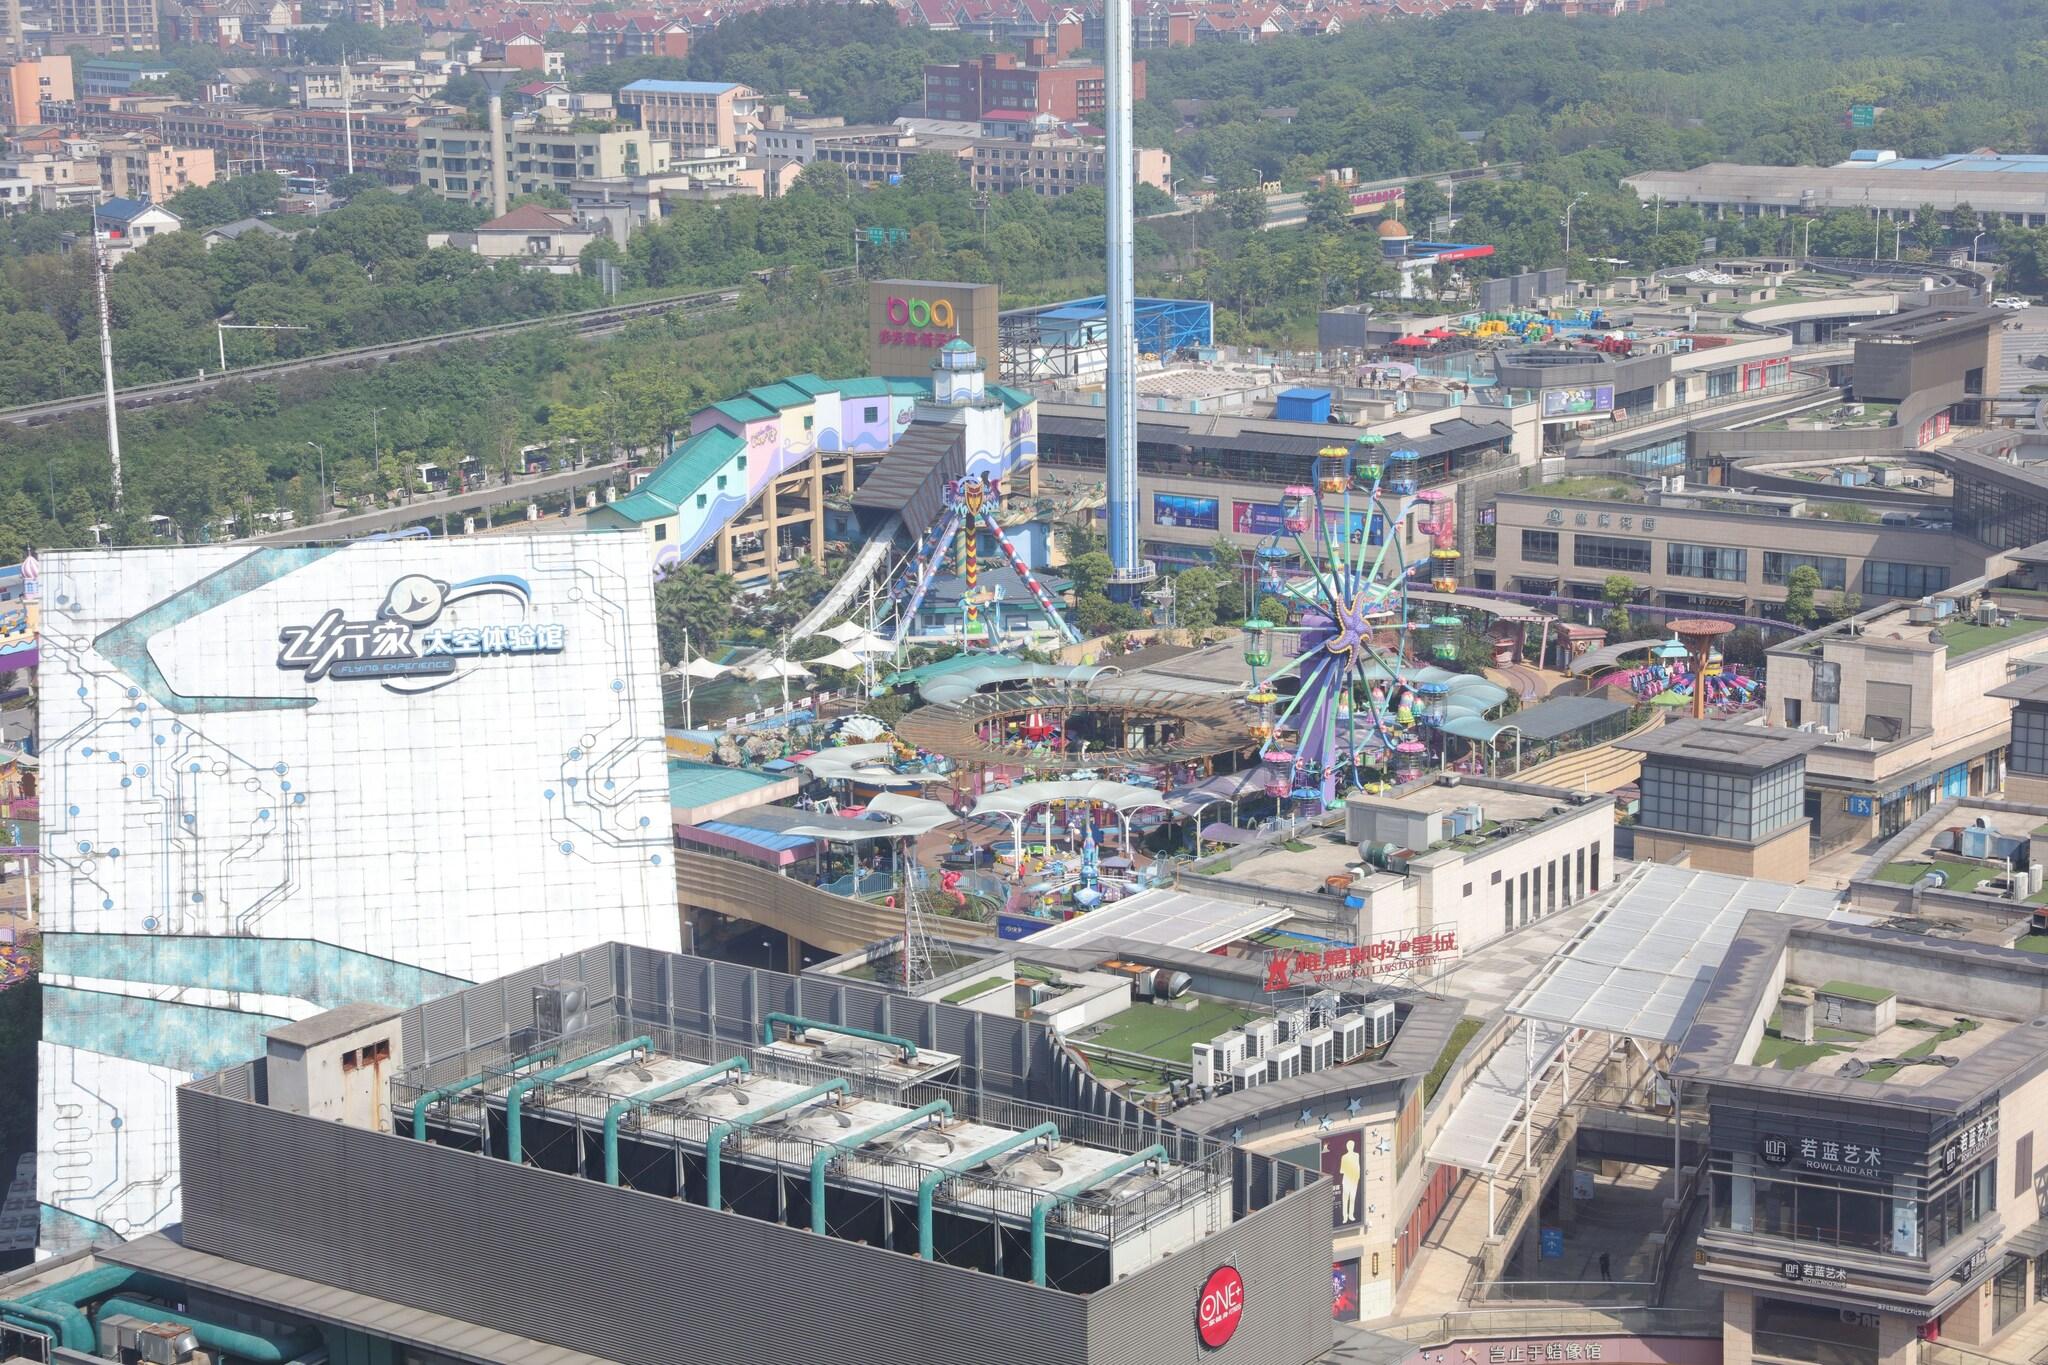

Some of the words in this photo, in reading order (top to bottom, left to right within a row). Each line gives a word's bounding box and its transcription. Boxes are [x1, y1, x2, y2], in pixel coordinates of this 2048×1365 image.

[281, 611, 413, 677] 飞行家
[423, 623, 566, 655] 太空体验馆
[340, 665, 379, 674] FLYING
[382, 660, 451, 672] EXPERIENCE
[1416, 957, 1439, 967] CITY
[1800, 1138, 1881, 1166] 若蓝艺术
[1806, 1160, 1857, 1174] ROWLAND
[1859, 1167, 1880, 1177] ART
[1803, 1264, 1847, 1281] 若蓝艺术
[1489, 1343, 1603, 1363] 岂止于蜡像馆
